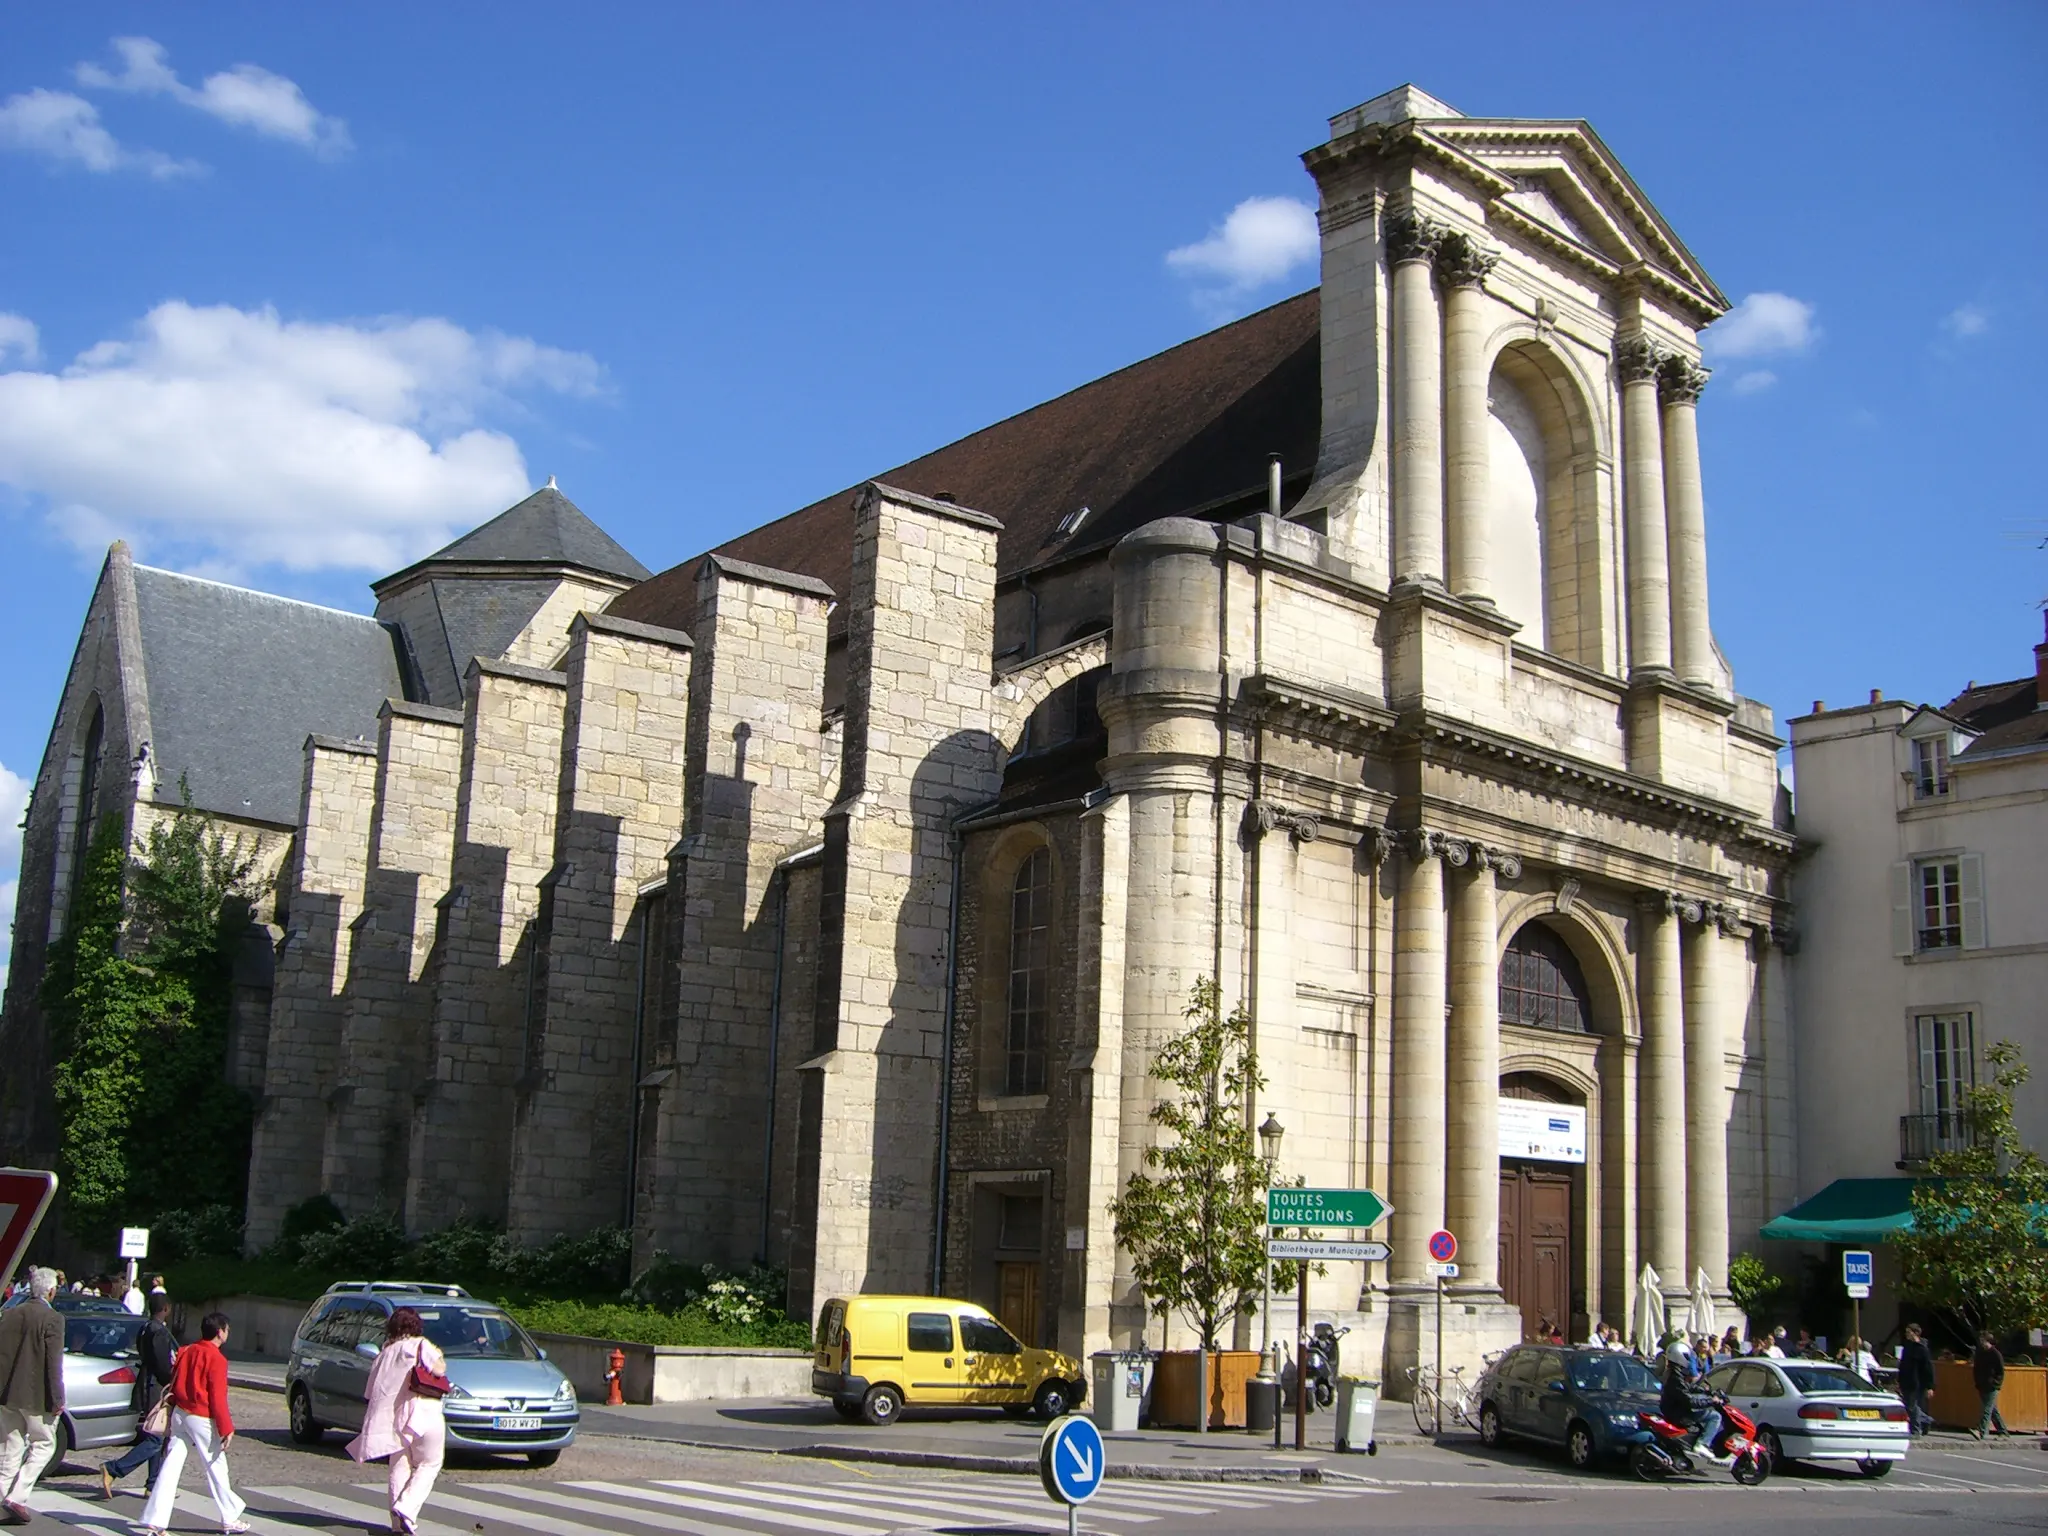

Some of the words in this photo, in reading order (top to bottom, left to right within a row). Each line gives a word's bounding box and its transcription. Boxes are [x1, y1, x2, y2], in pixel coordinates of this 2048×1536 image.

[1273, 1193, 1324, 1206] TOUTES
[1272, 1209, 1354, 1222] DIRECTIONS
[1270, 1244, 1325, 1255] Bibliothèque
[1328, 1247, 1377, 1256] Municipale
[1847, 1263, 1869, 1274] TAXIS
